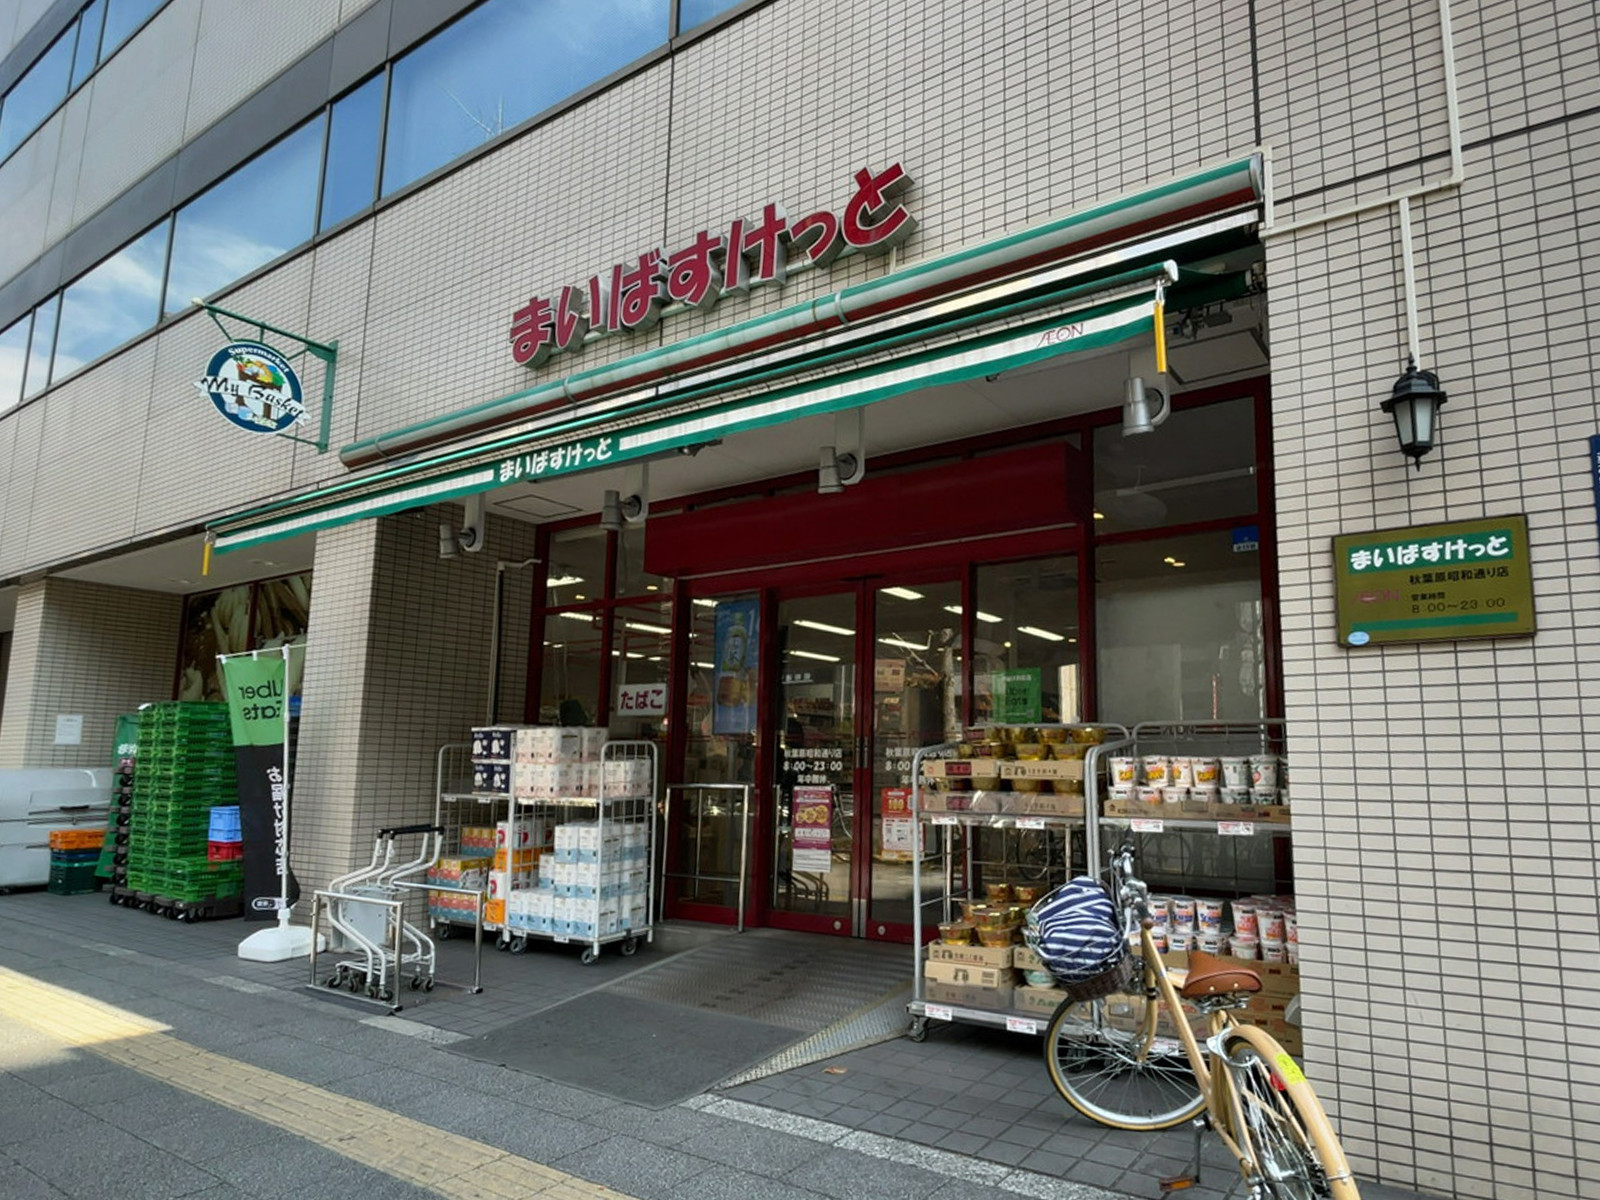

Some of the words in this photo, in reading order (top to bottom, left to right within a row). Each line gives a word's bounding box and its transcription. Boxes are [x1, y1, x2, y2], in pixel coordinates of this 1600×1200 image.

[510, 162, 909, 366] まいばすけっと
[227, 347, 290, 373] Supermarket
[200, 376, 240, 397] My
[499, 437, 613, 482] まいばすけっと
[1350, 535, 1509, 570] まいばすけっと
[1409, 566, 1509, 585] 秋葉原昭和通り店
[620, 689, 664, 710] たばこ
